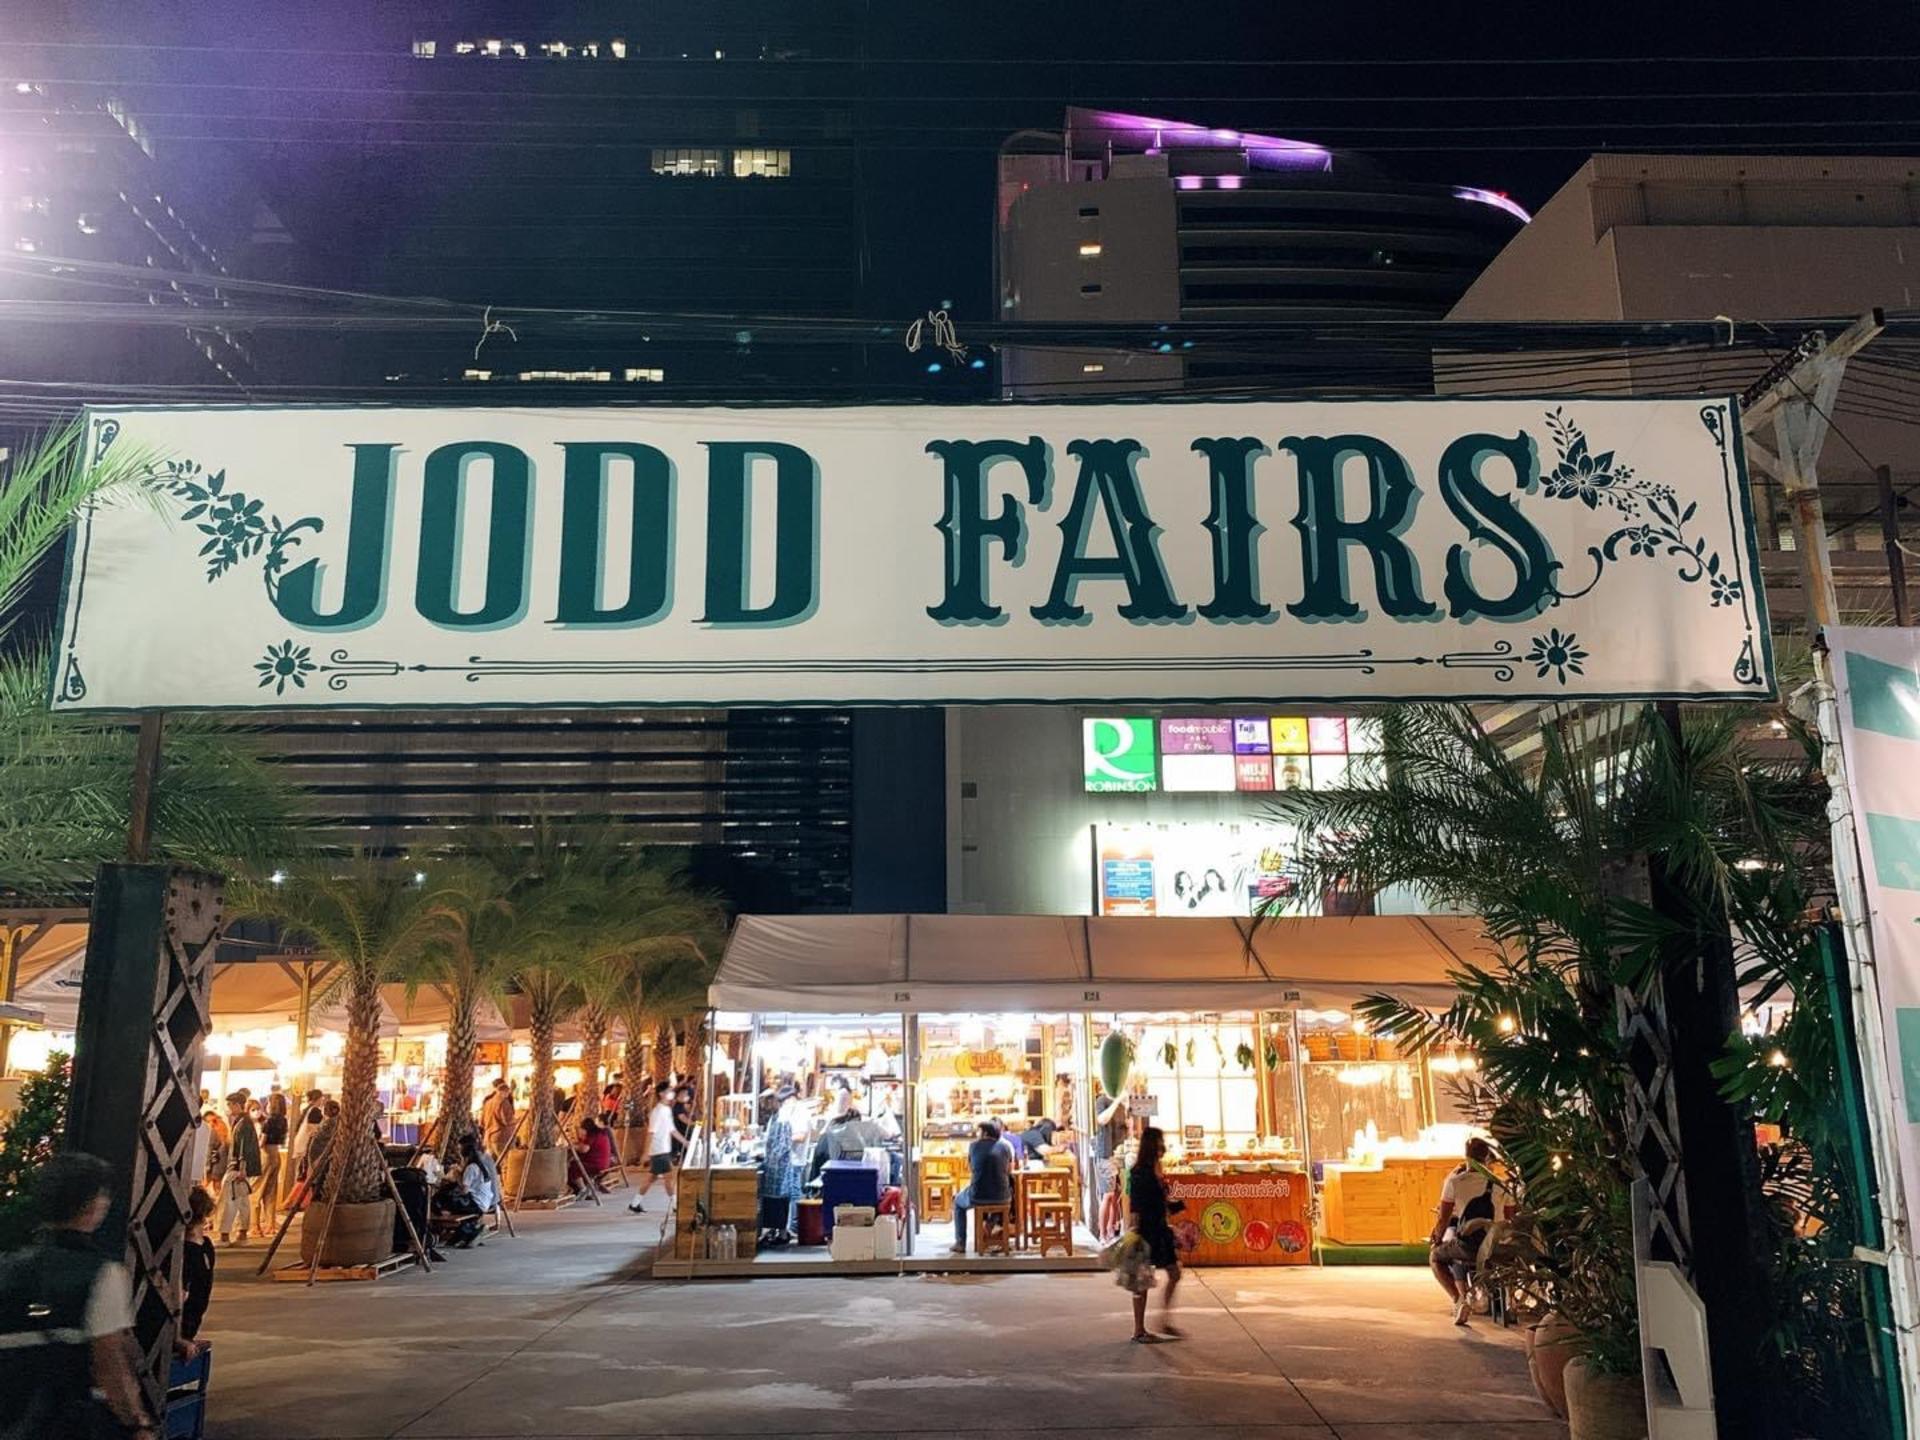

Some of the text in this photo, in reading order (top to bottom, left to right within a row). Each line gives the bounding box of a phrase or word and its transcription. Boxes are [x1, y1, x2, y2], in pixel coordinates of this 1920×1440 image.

[277, 429, 1547, 634] JODD FAIRS
[1085, 781, 1157, 792] ROBINSON
